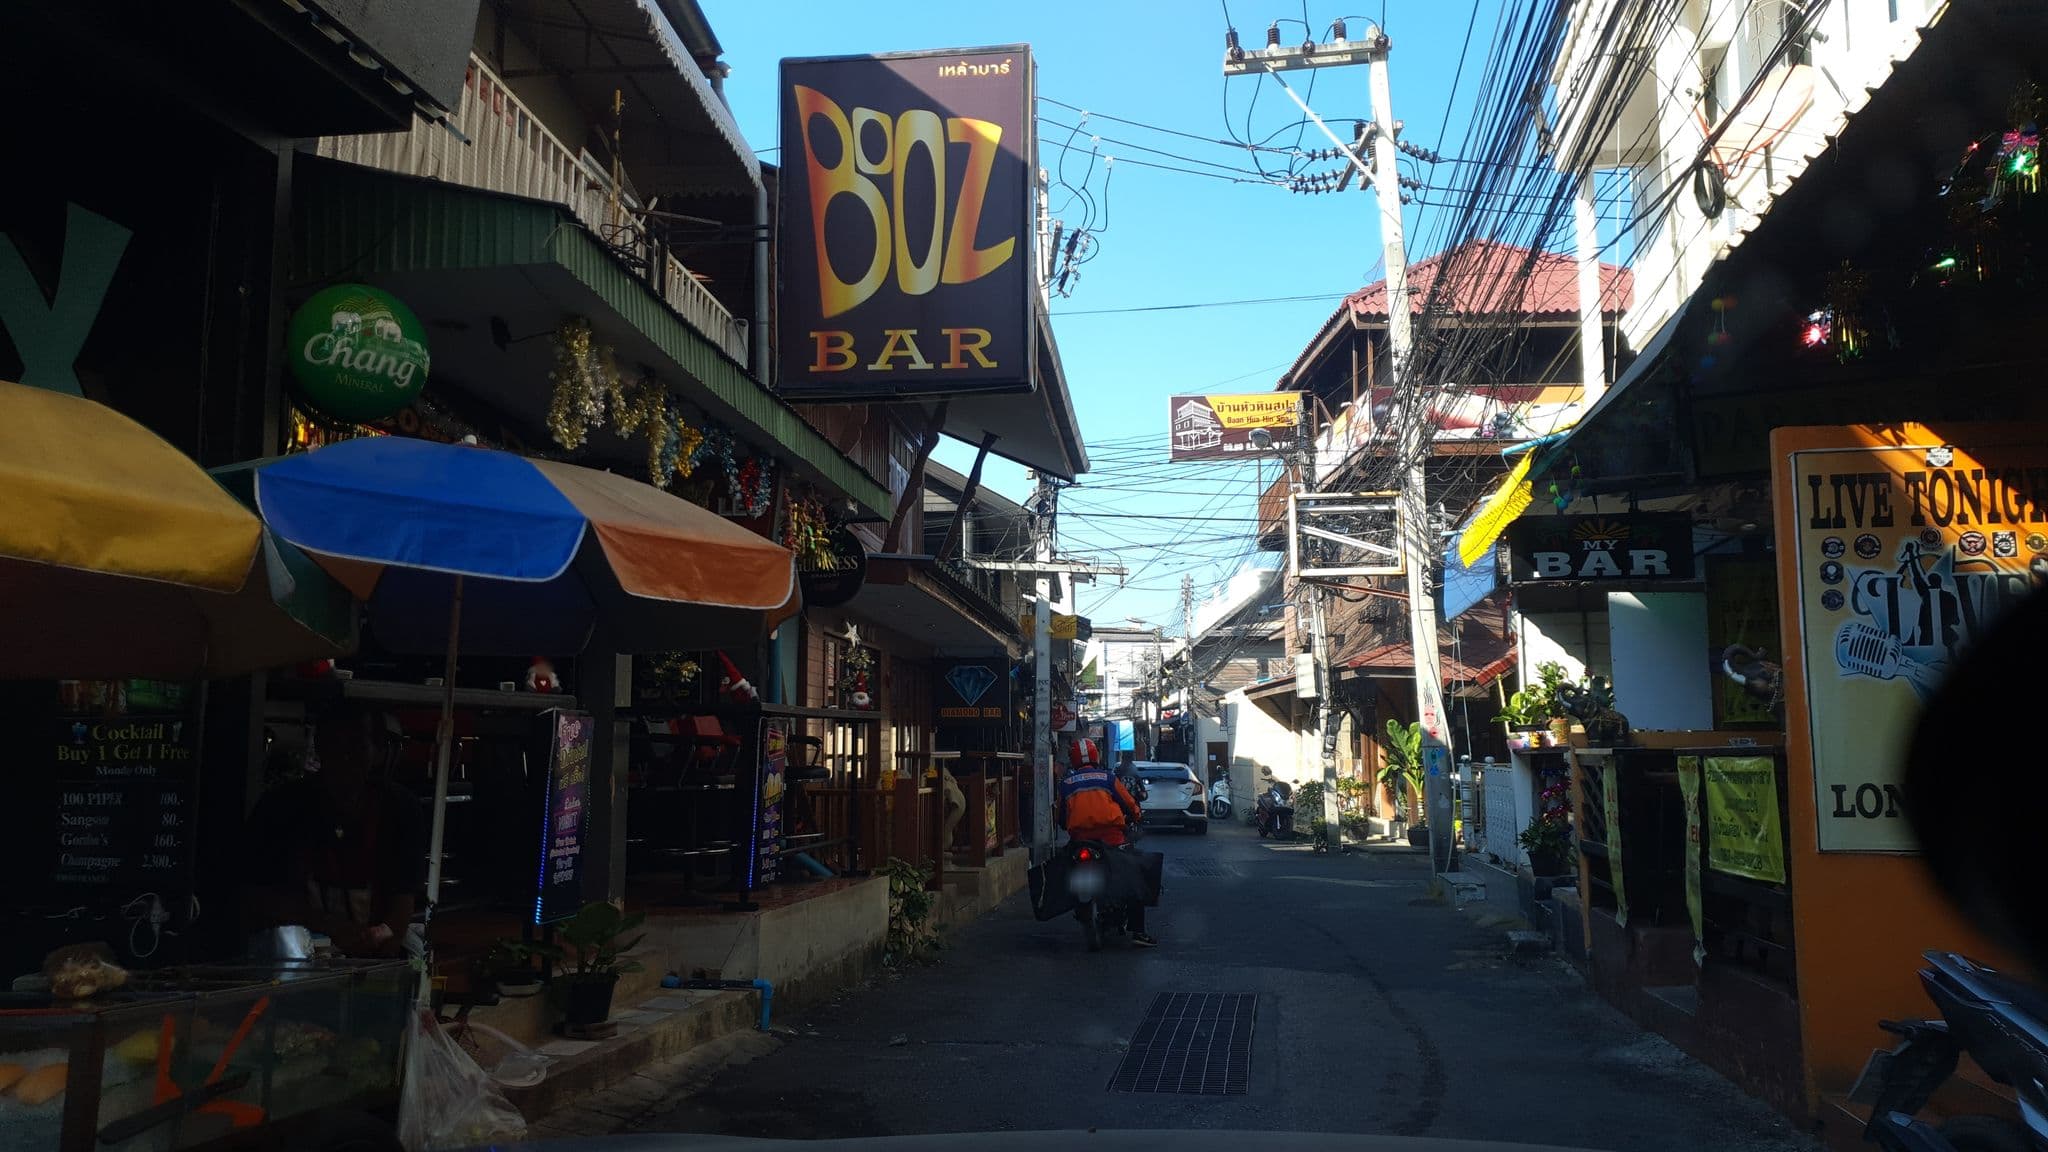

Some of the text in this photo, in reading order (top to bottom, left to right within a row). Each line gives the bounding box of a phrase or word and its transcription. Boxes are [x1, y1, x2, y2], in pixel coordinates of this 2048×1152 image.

[304, 331, 418, 388] Chang
[808, 328, 998, 372] BAR
[1807, 473, 1893, 529] LIVE
[1583, 540, 1618, 550] MY
[1532, 549, 1672, 577] BAR
[983, 707, 1001, 718] BAR
[92, 723, 164, 740] Cocktail
[57, 745, 89, 765] Buy
[114, 743, 141, 760] Get
[160, 744, 191, 760] Free
[134, 765, 157, 777] Only
